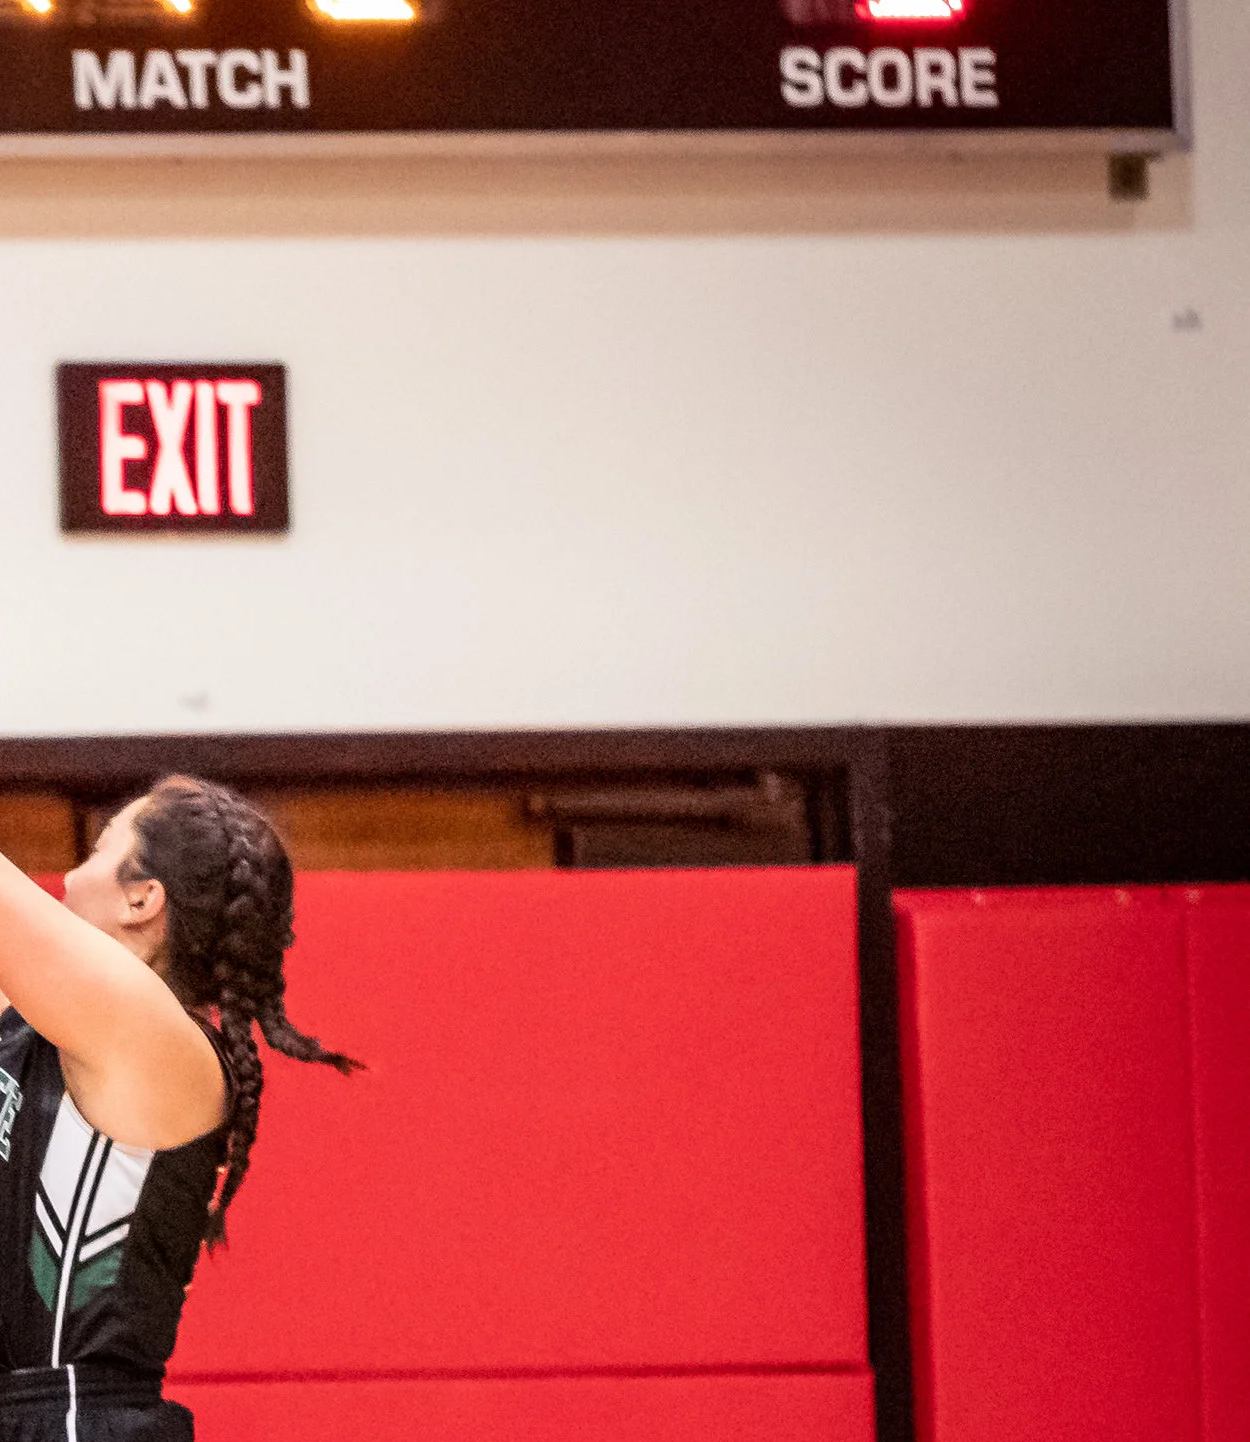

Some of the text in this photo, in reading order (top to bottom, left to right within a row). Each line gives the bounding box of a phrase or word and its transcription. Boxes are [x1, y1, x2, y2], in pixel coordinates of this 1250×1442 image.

[71, 48, 310, 110] MATCH
[779, 46, 1000, 108] SCORE
[98, 378, 263, 517] EXIT
